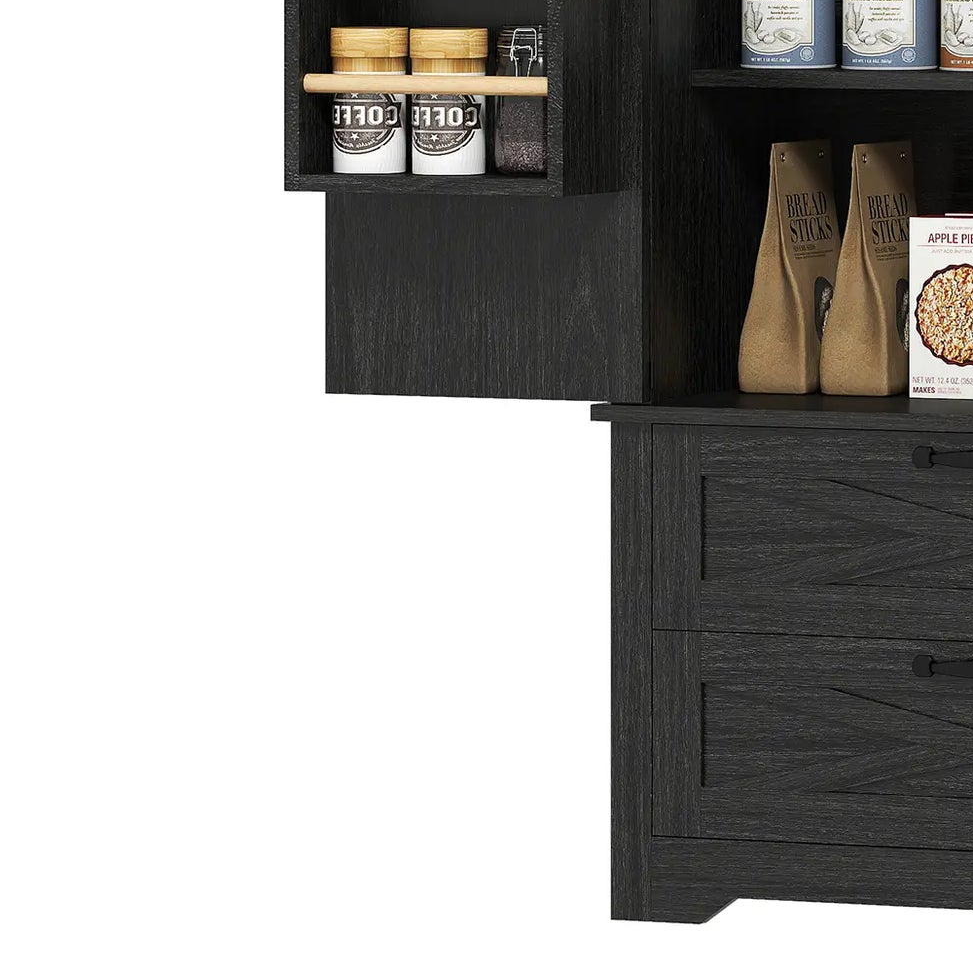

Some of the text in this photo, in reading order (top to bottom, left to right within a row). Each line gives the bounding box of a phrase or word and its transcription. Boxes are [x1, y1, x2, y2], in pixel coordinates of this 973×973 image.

[786, 191, 827, 218] BREAD
[867, 193, 908, 220] BREAD
[789, 215, 833, 243] STICKS
[928, 233, 958, 244] APPLE
